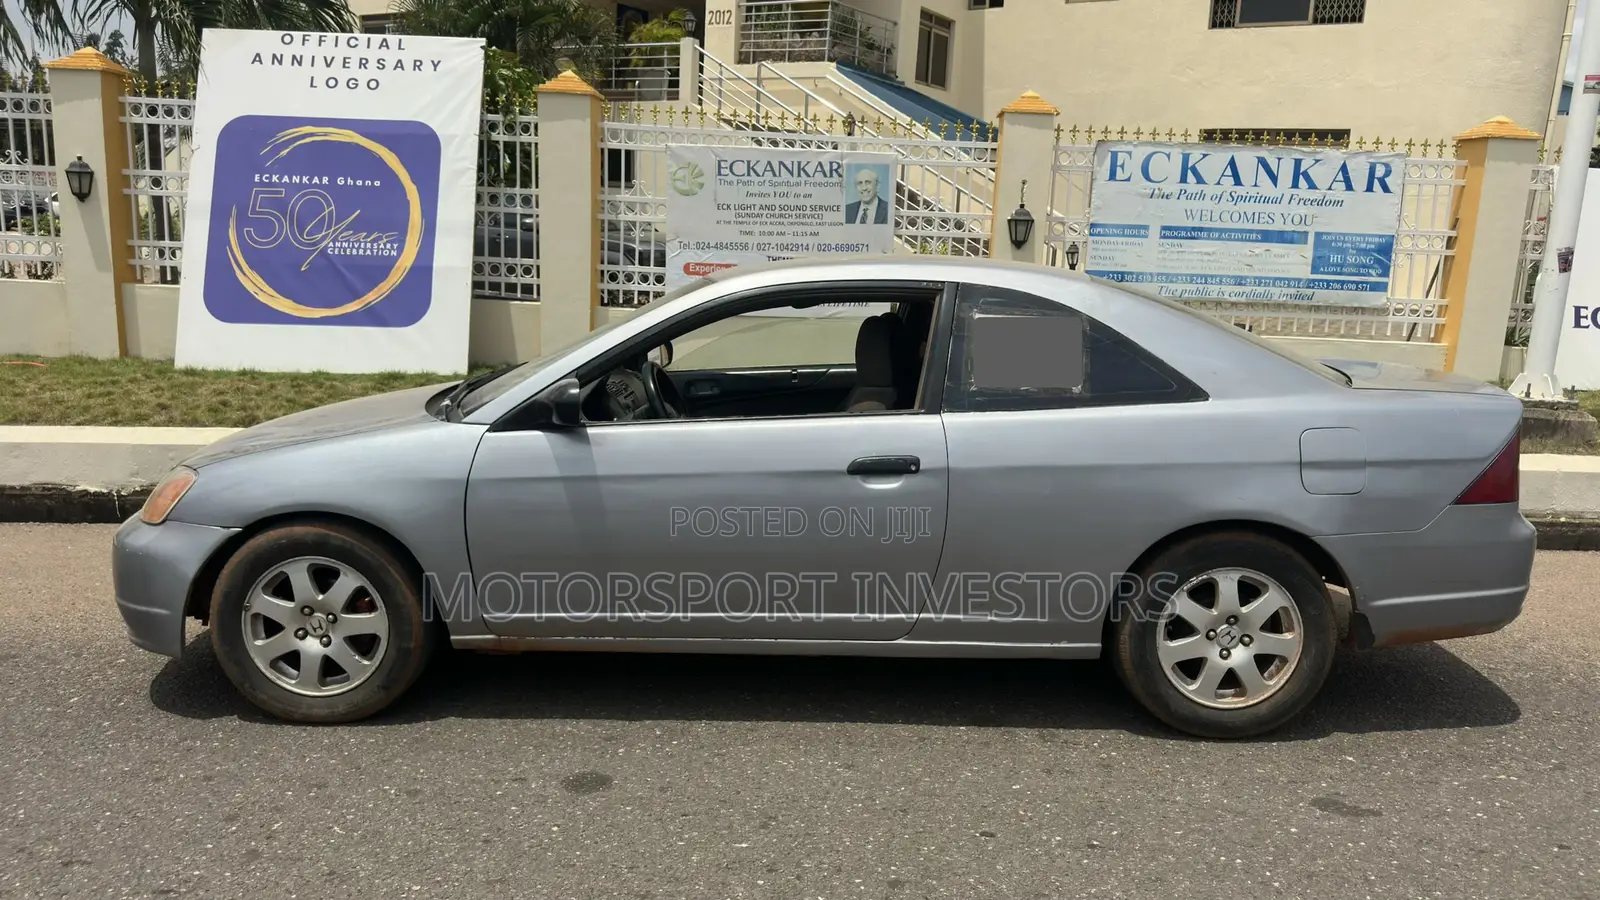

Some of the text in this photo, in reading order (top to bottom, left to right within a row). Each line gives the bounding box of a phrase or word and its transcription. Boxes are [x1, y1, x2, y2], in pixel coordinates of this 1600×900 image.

[708, 10, 732, 26] 2012
[280, 32, 406, 51] OFFICIAL
[251, 52, 442, 72] ANNIVERSARY
[310, 76, 380, 91] LOGO
[716, 160, 843, 179] ECKANKAR
[1106, 150, 1394, 194] ECKANKAR
[254, 174, 381, 187] ECKANKAR Ghana
[718, 178, 842, 189] The Path of Spiritual Freedom
[746, 190, 771, 198] Invites
[1148, 186, 1344, 208] The Path of Spiritual Freedom
[717, 203, 732, 211] ECK
[244, 188, 336, 250] 50
[1184, 208, 1315, 227] WELCOMES YOU
[300, 206, 398, 272] Years
[1161, 230, 1209, 238] PROGRAMME
[328, 241, 399, 250] ANNIVERSARY
[328, 248, 398, 256] CELEBRATION
[678, 241, 750, 251] Tel.:024-4845556
[756, 243, 810, 252] 027-1042914
[817, 244, 870, 252] 020-6690571
[1330, 254, 1374, 265] HU SONG
[1158, 286, 1315, 300] The public is cordially invited
